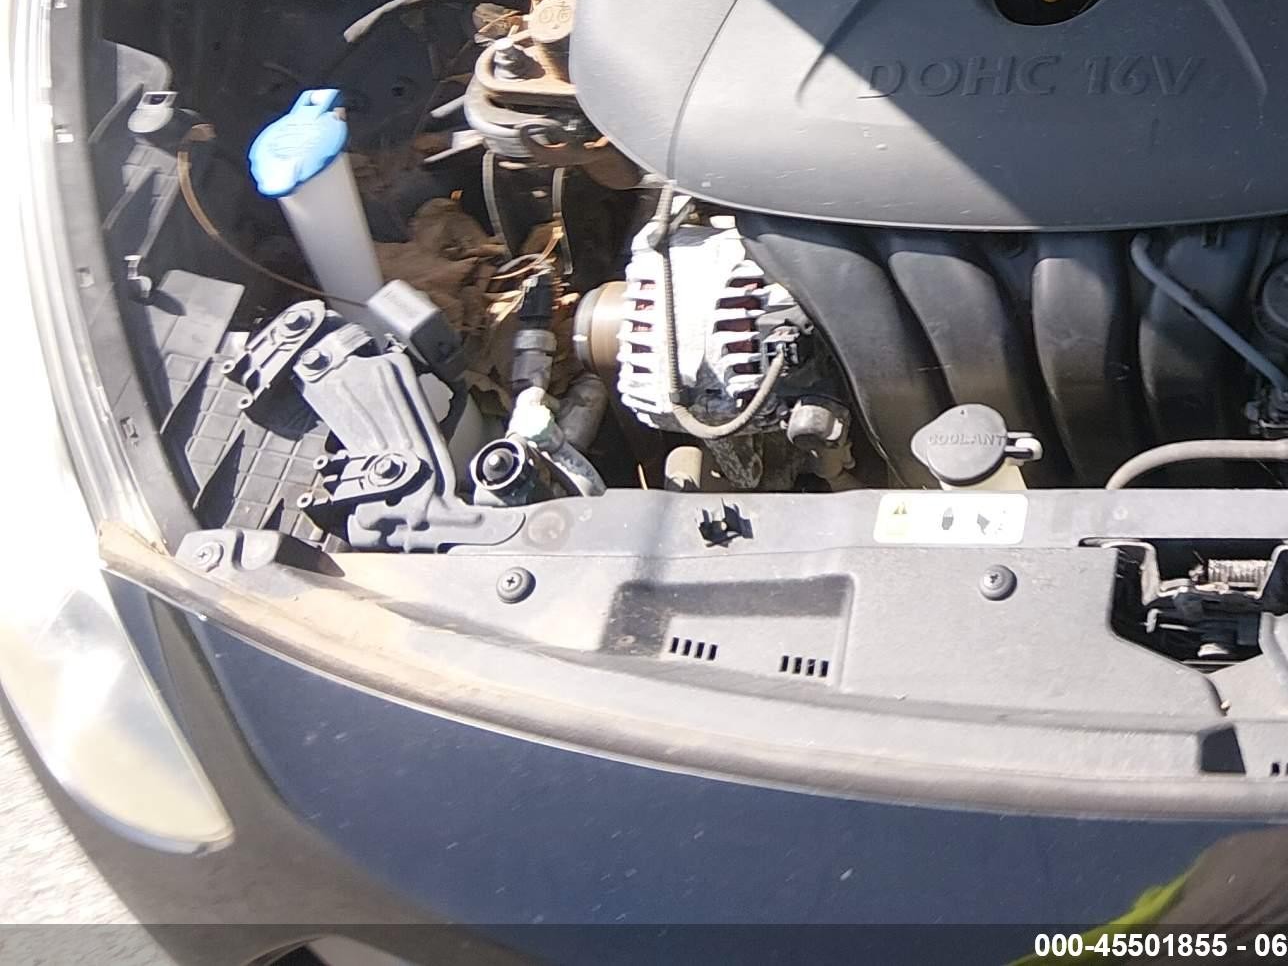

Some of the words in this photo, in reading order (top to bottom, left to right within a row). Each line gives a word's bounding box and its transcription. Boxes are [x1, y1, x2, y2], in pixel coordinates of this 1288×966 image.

[857, 54, 1060, 99] DOHC
[1084, 54, 1205, 97] 16V
[928, 433, 1008, 447] COOLANT
